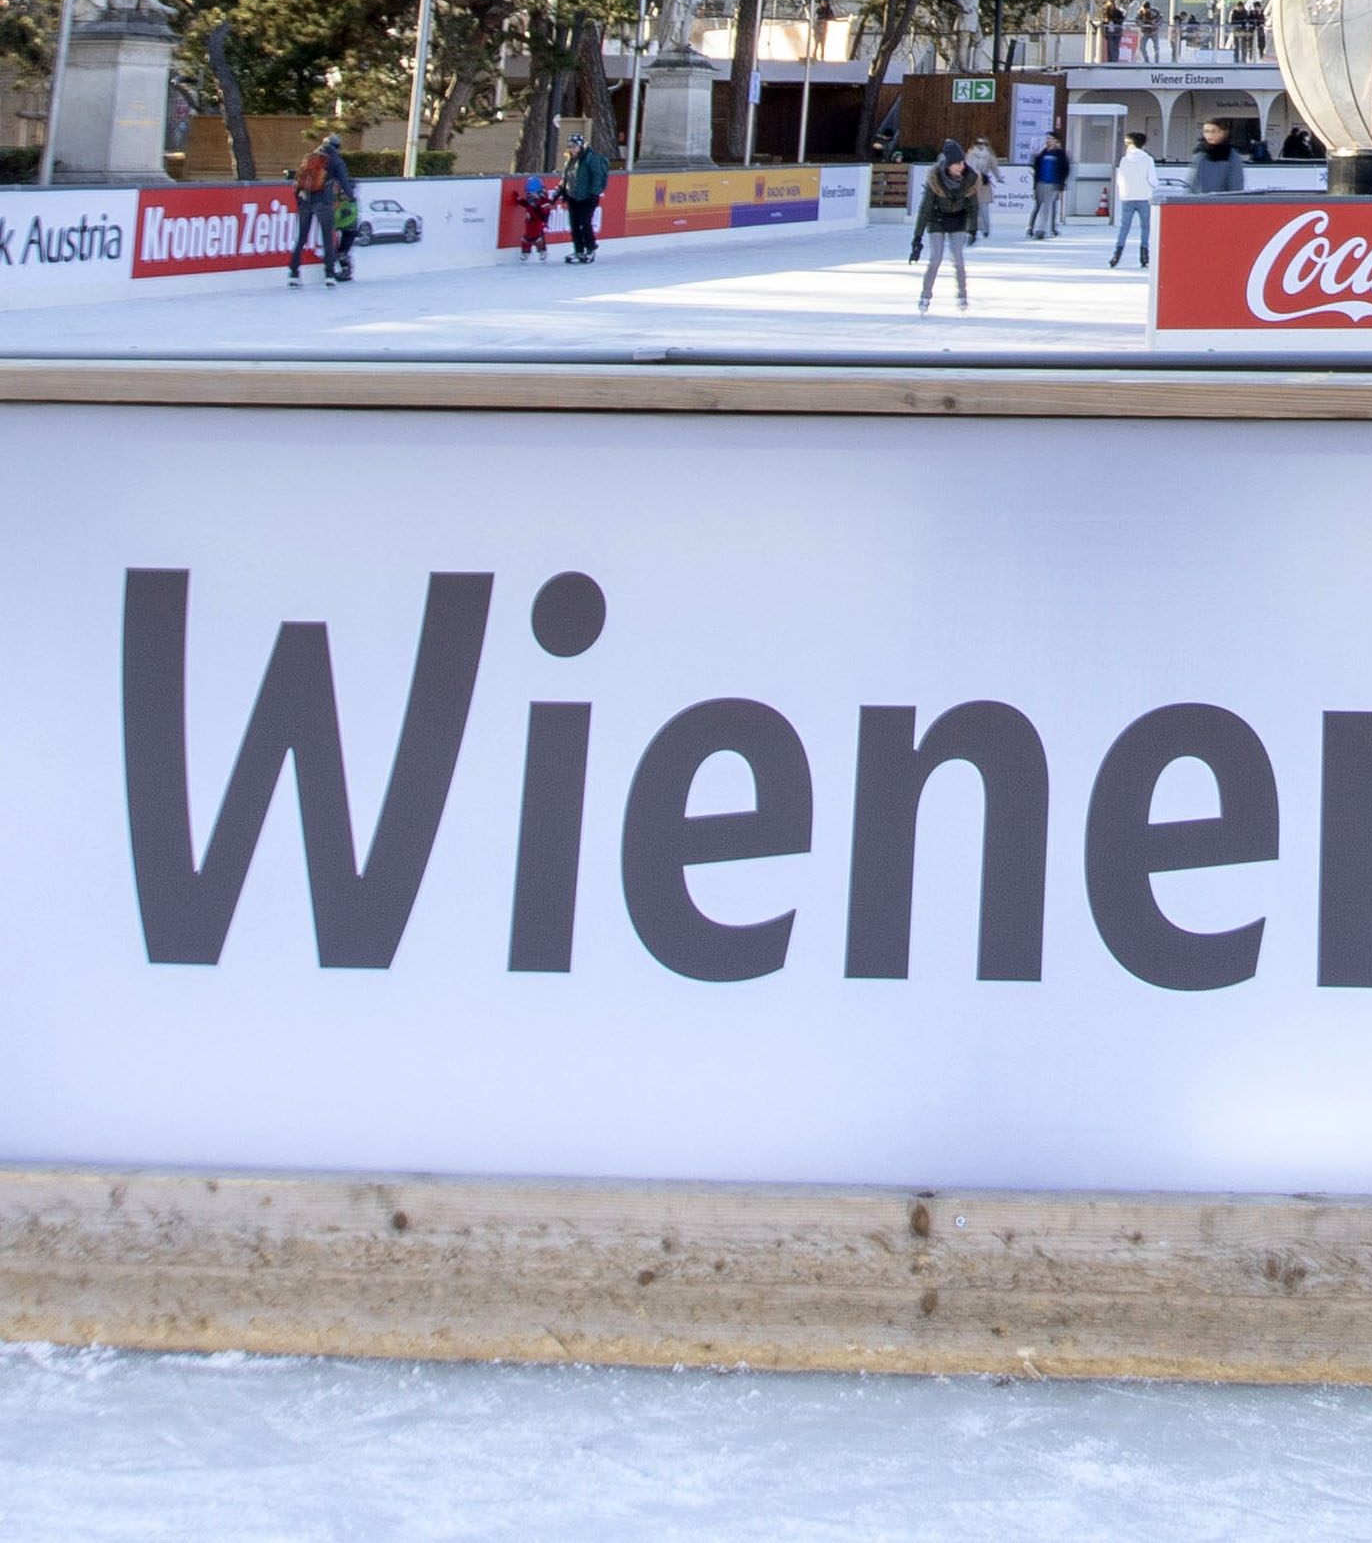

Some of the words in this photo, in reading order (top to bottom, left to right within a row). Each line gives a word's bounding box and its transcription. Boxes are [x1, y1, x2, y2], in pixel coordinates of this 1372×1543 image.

[1150, 73, 1183, 85] Wiener
[1185, 73, 1224, 85] Eistraum
[20, 213, 122, 264] Austria
[140, 206, 239, 262] Kronen
